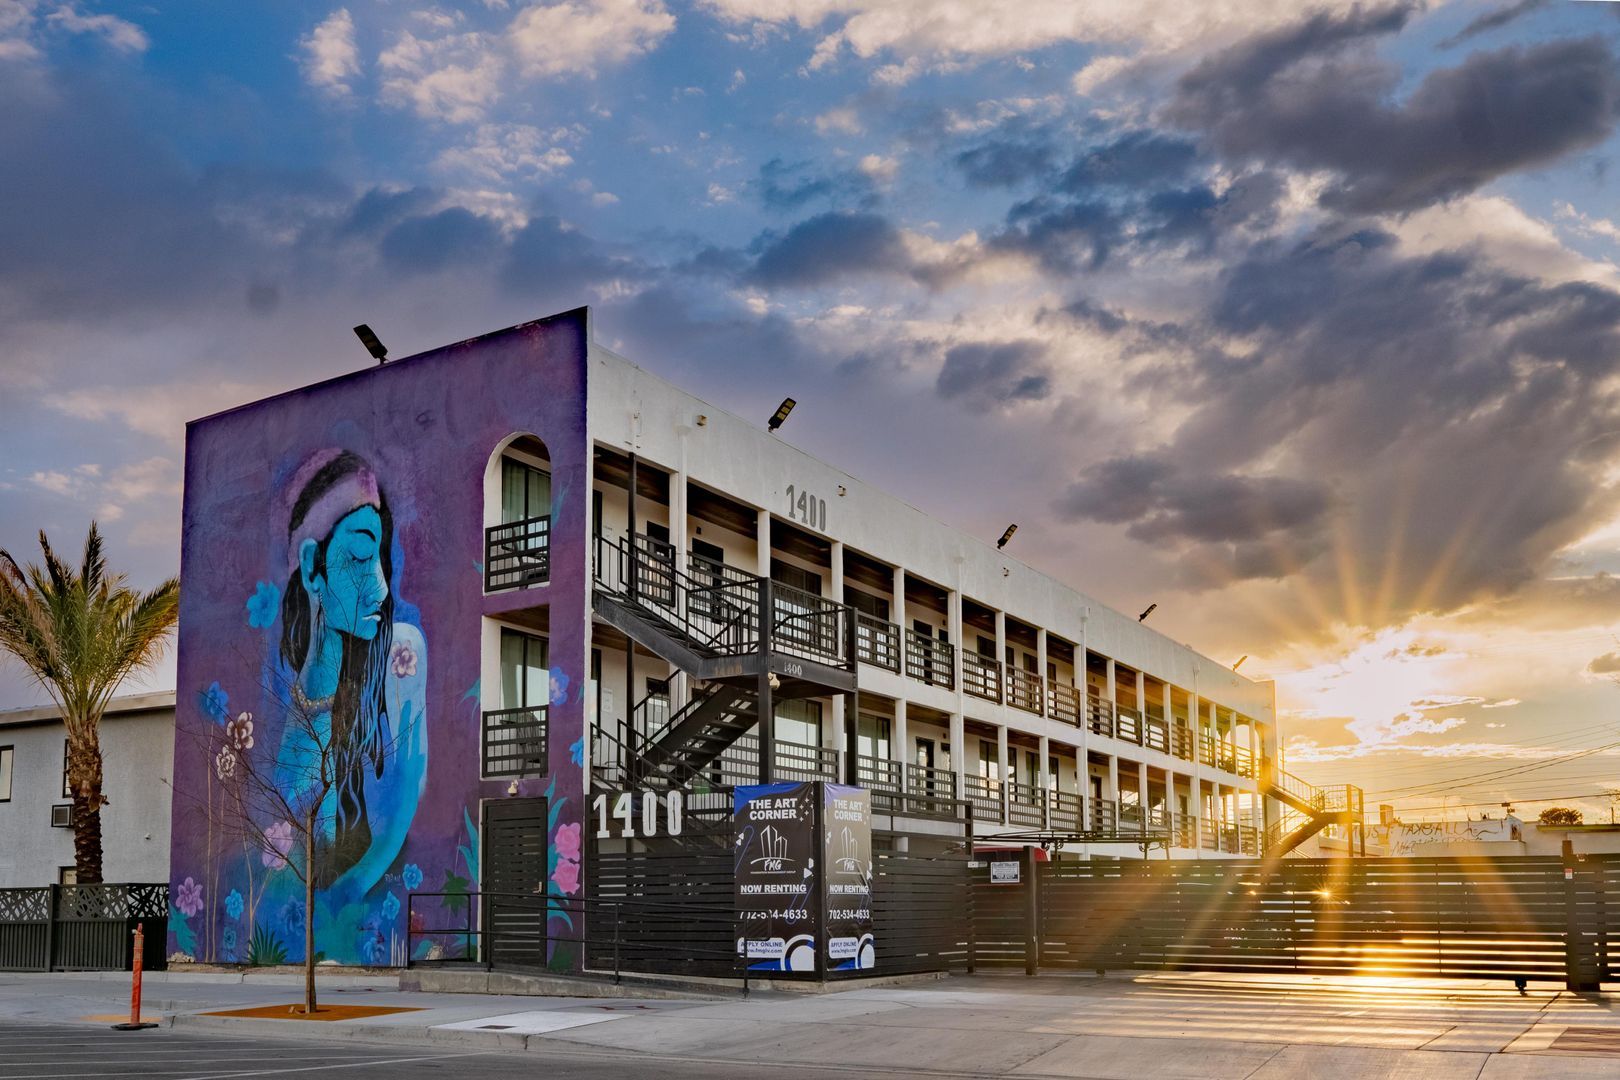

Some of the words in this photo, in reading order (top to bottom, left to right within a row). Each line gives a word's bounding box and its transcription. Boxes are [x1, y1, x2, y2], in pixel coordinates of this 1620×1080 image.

[786, 484, 826, 532] 1400
[783, 662, 803, 677] 1400
[749, 799, 772, 809] THE
[774, 798, 798, 808] ART
[834, 799, 848, 809] THE
[849, 801, 863, 811] ART
[593, 790, 682, 838] 1400
[749, 809, 798, 820] CORNER
[834, 810, 863, 821] CORNER
[740, 885, 762, 893] NOW
[764, 884, 807, 893] RENTING
[829, 884, 844, 893] NOW
[844, 885, 869, 894] RENTING
[829, 909, 870, 919] 702-534-4633
